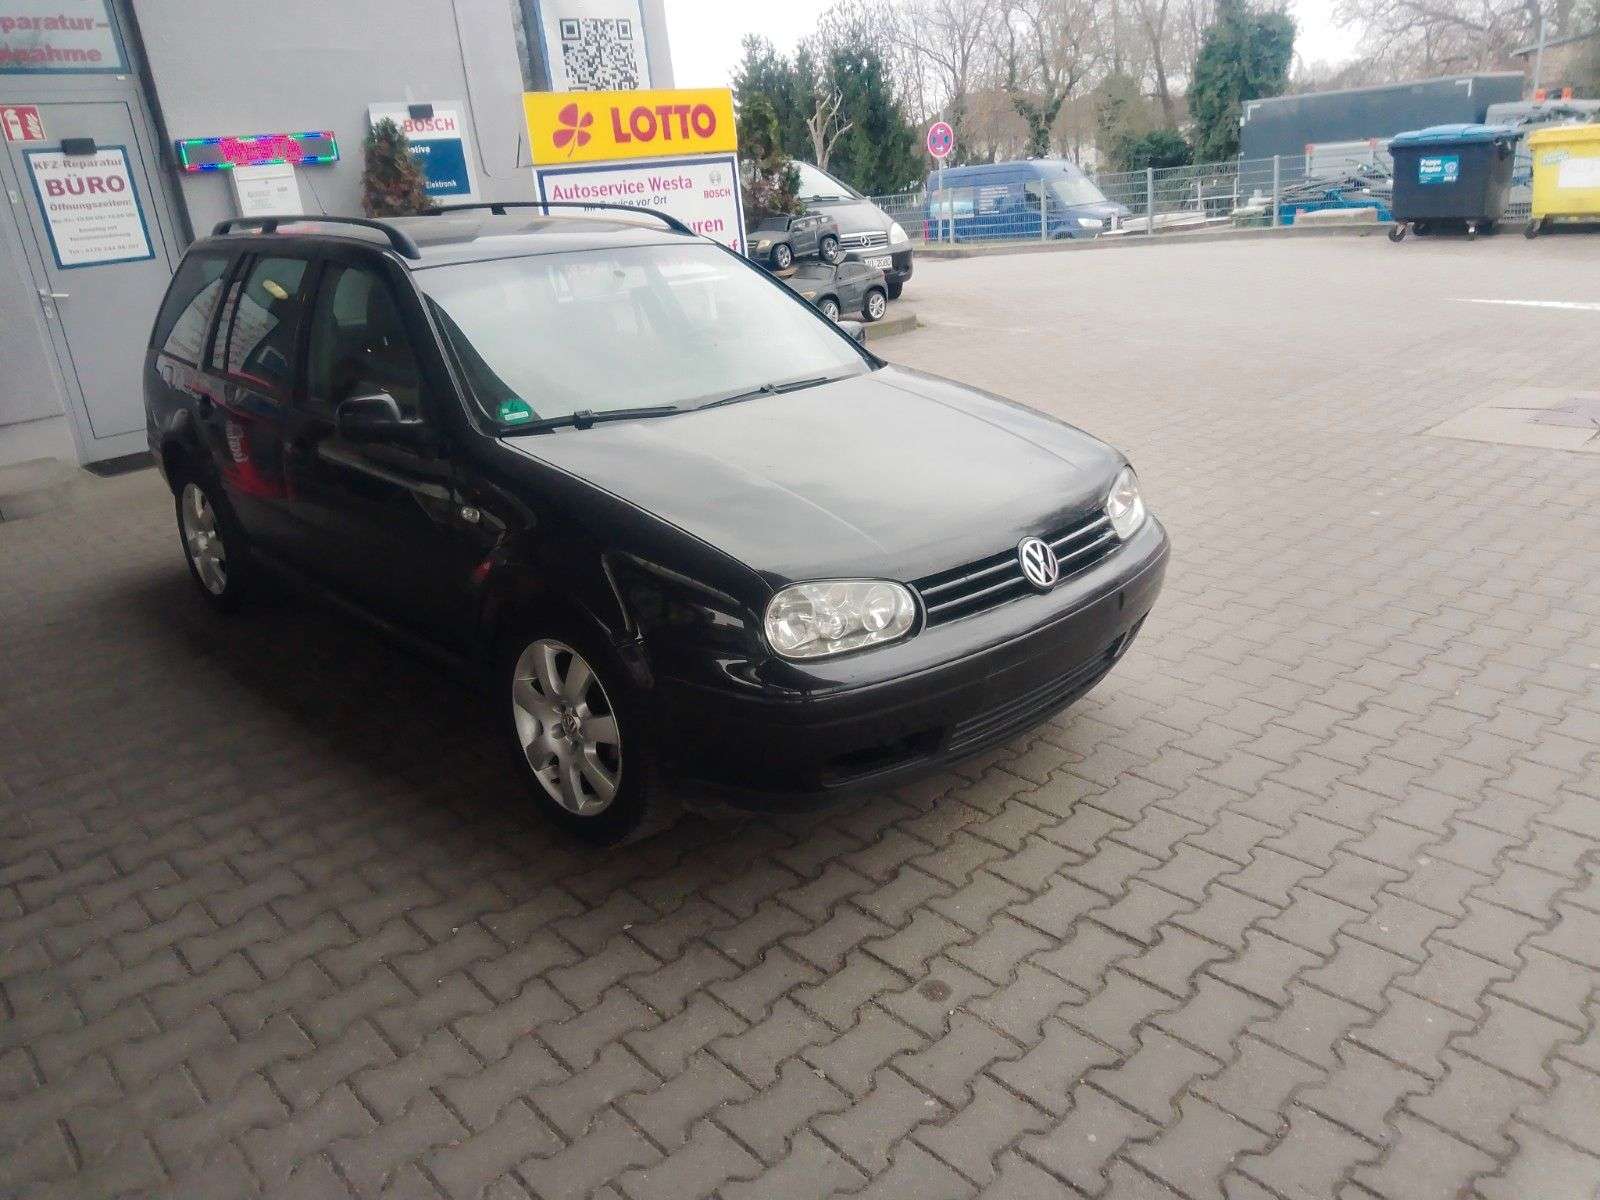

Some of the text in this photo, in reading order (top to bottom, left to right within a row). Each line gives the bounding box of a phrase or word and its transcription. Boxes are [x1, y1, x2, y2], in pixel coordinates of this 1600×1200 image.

[403, 118, 455, 132] BOSCH
[610, 104, 717, 143] LOTTO
[45, 174, 125, 196] BÜRO
[552, 175, 692, 200] Autoservice Westa
[703, 188, 731, 199] BOSCH
[636, 198, 651, 207] vor
